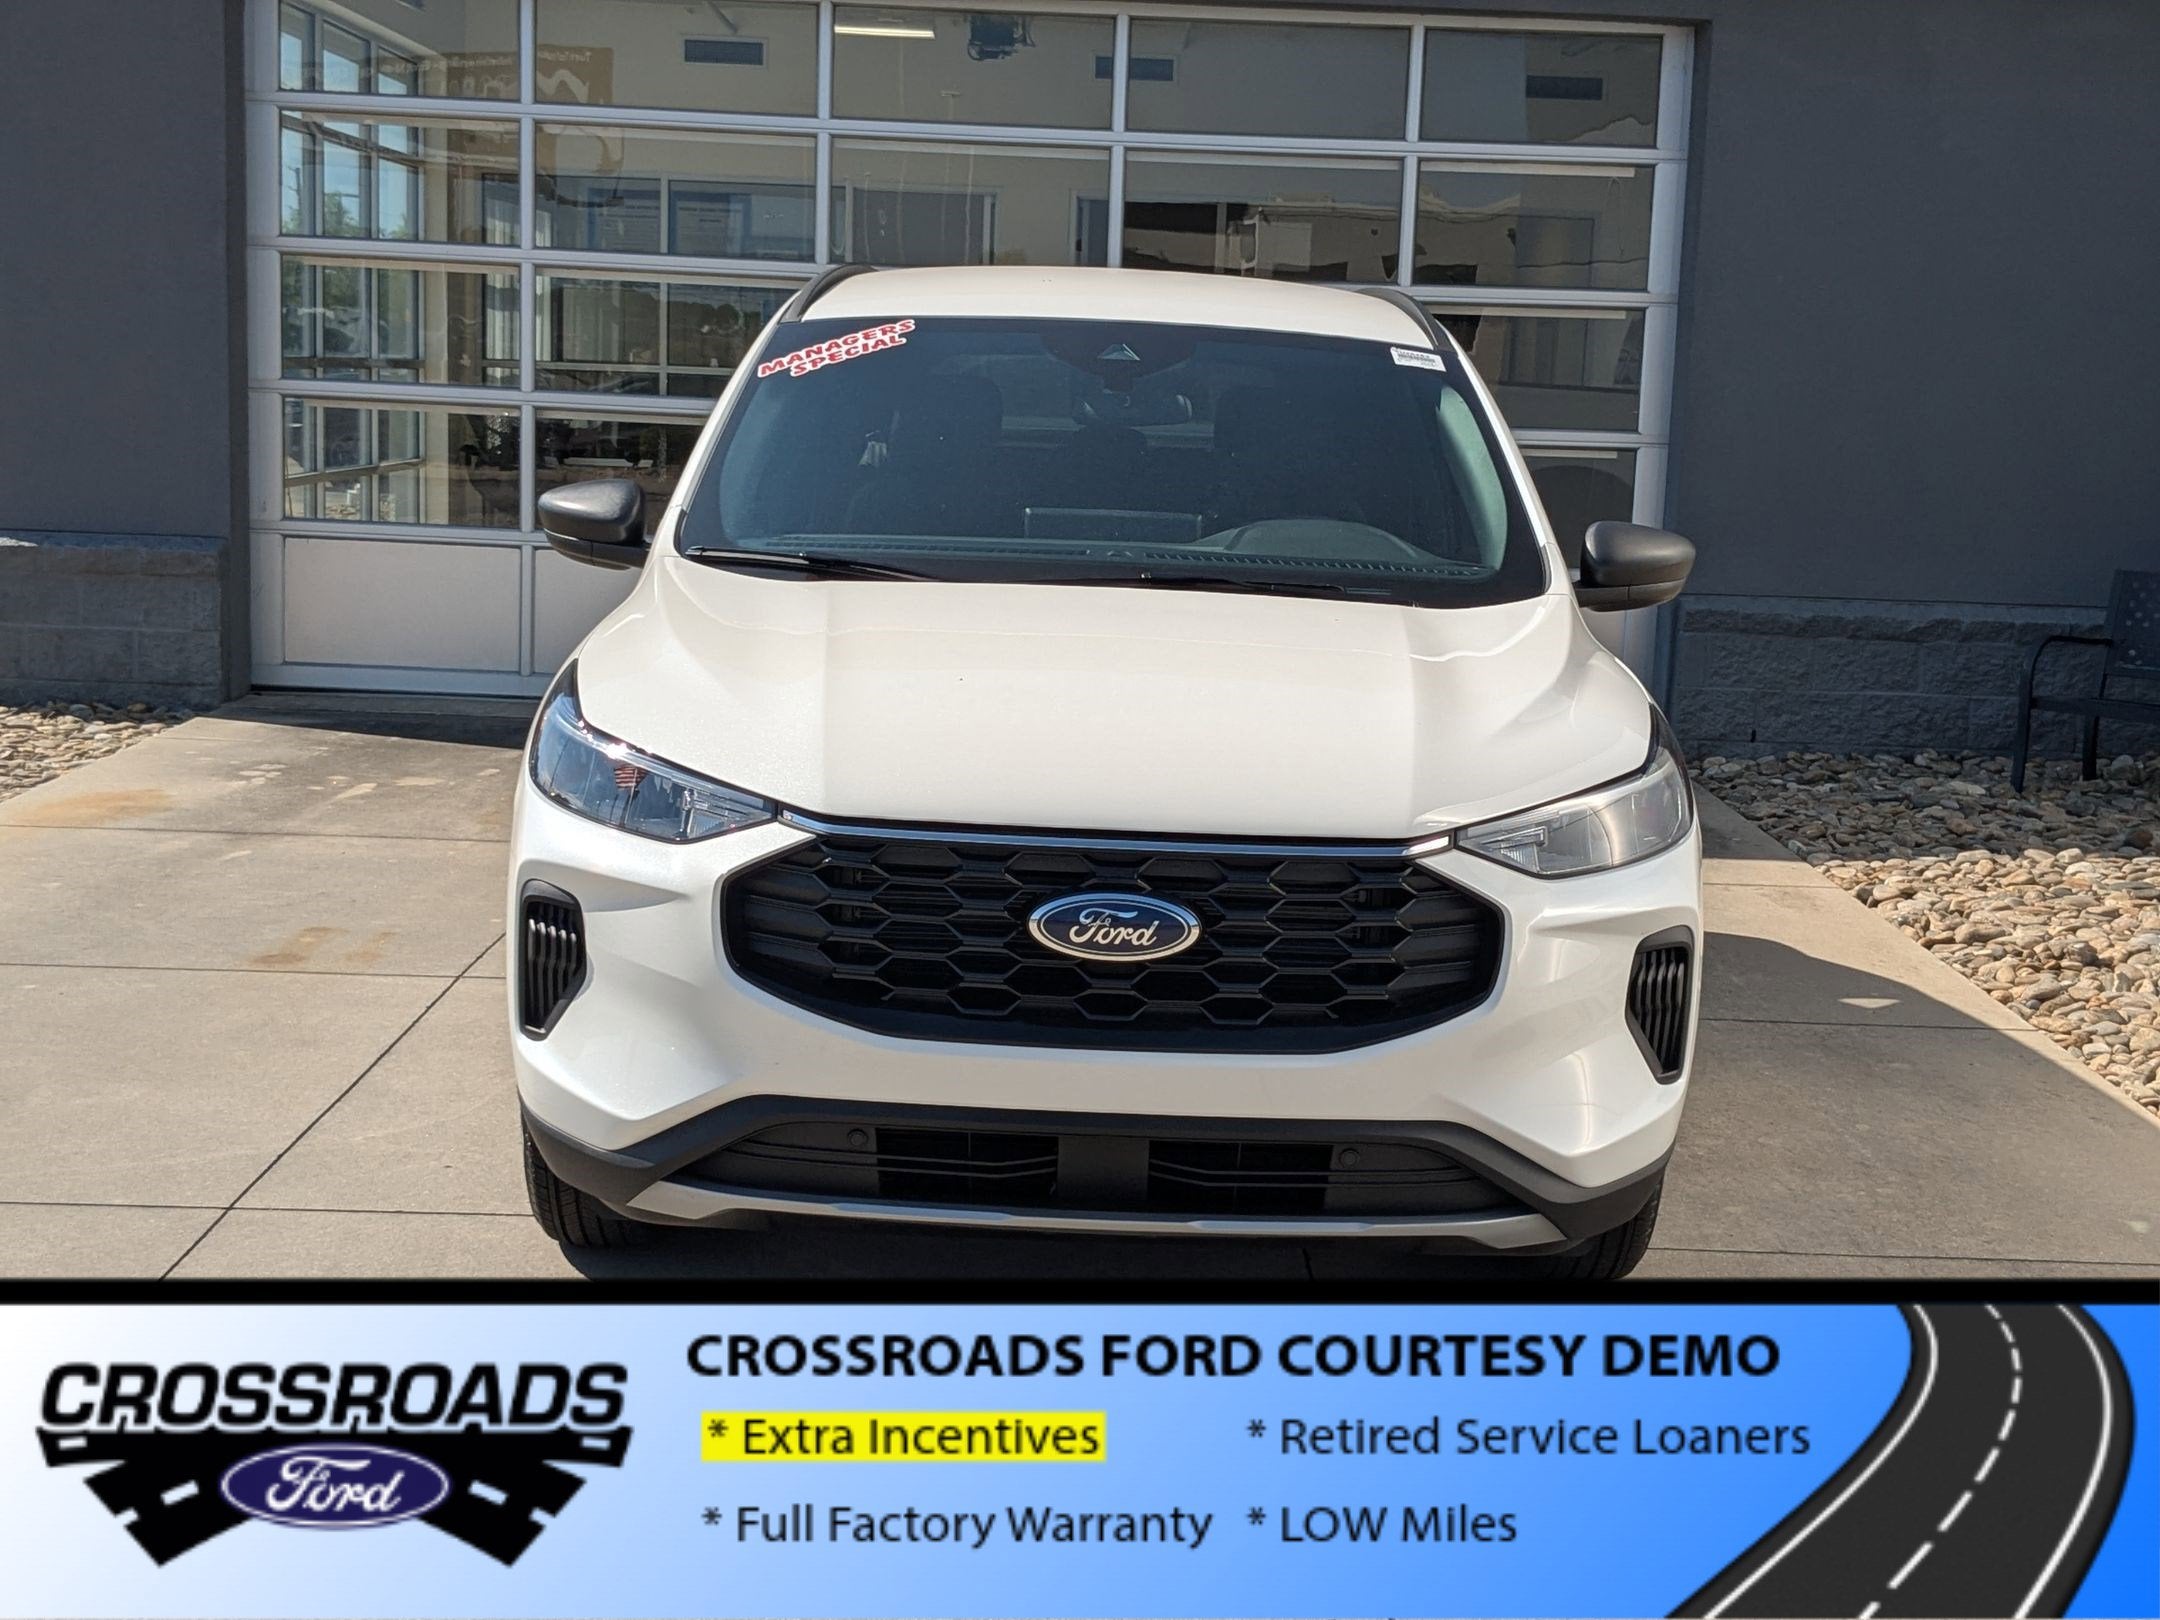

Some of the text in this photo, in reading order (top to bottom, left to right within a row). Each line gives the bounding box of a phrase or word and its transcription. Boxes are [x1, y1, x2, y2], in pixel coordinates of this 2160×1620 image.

[758, 319, 915, 377] MANAGERS
[791, 335, 907, 376] SPECIAL
[1069, 908, 1160, 944] Ford
